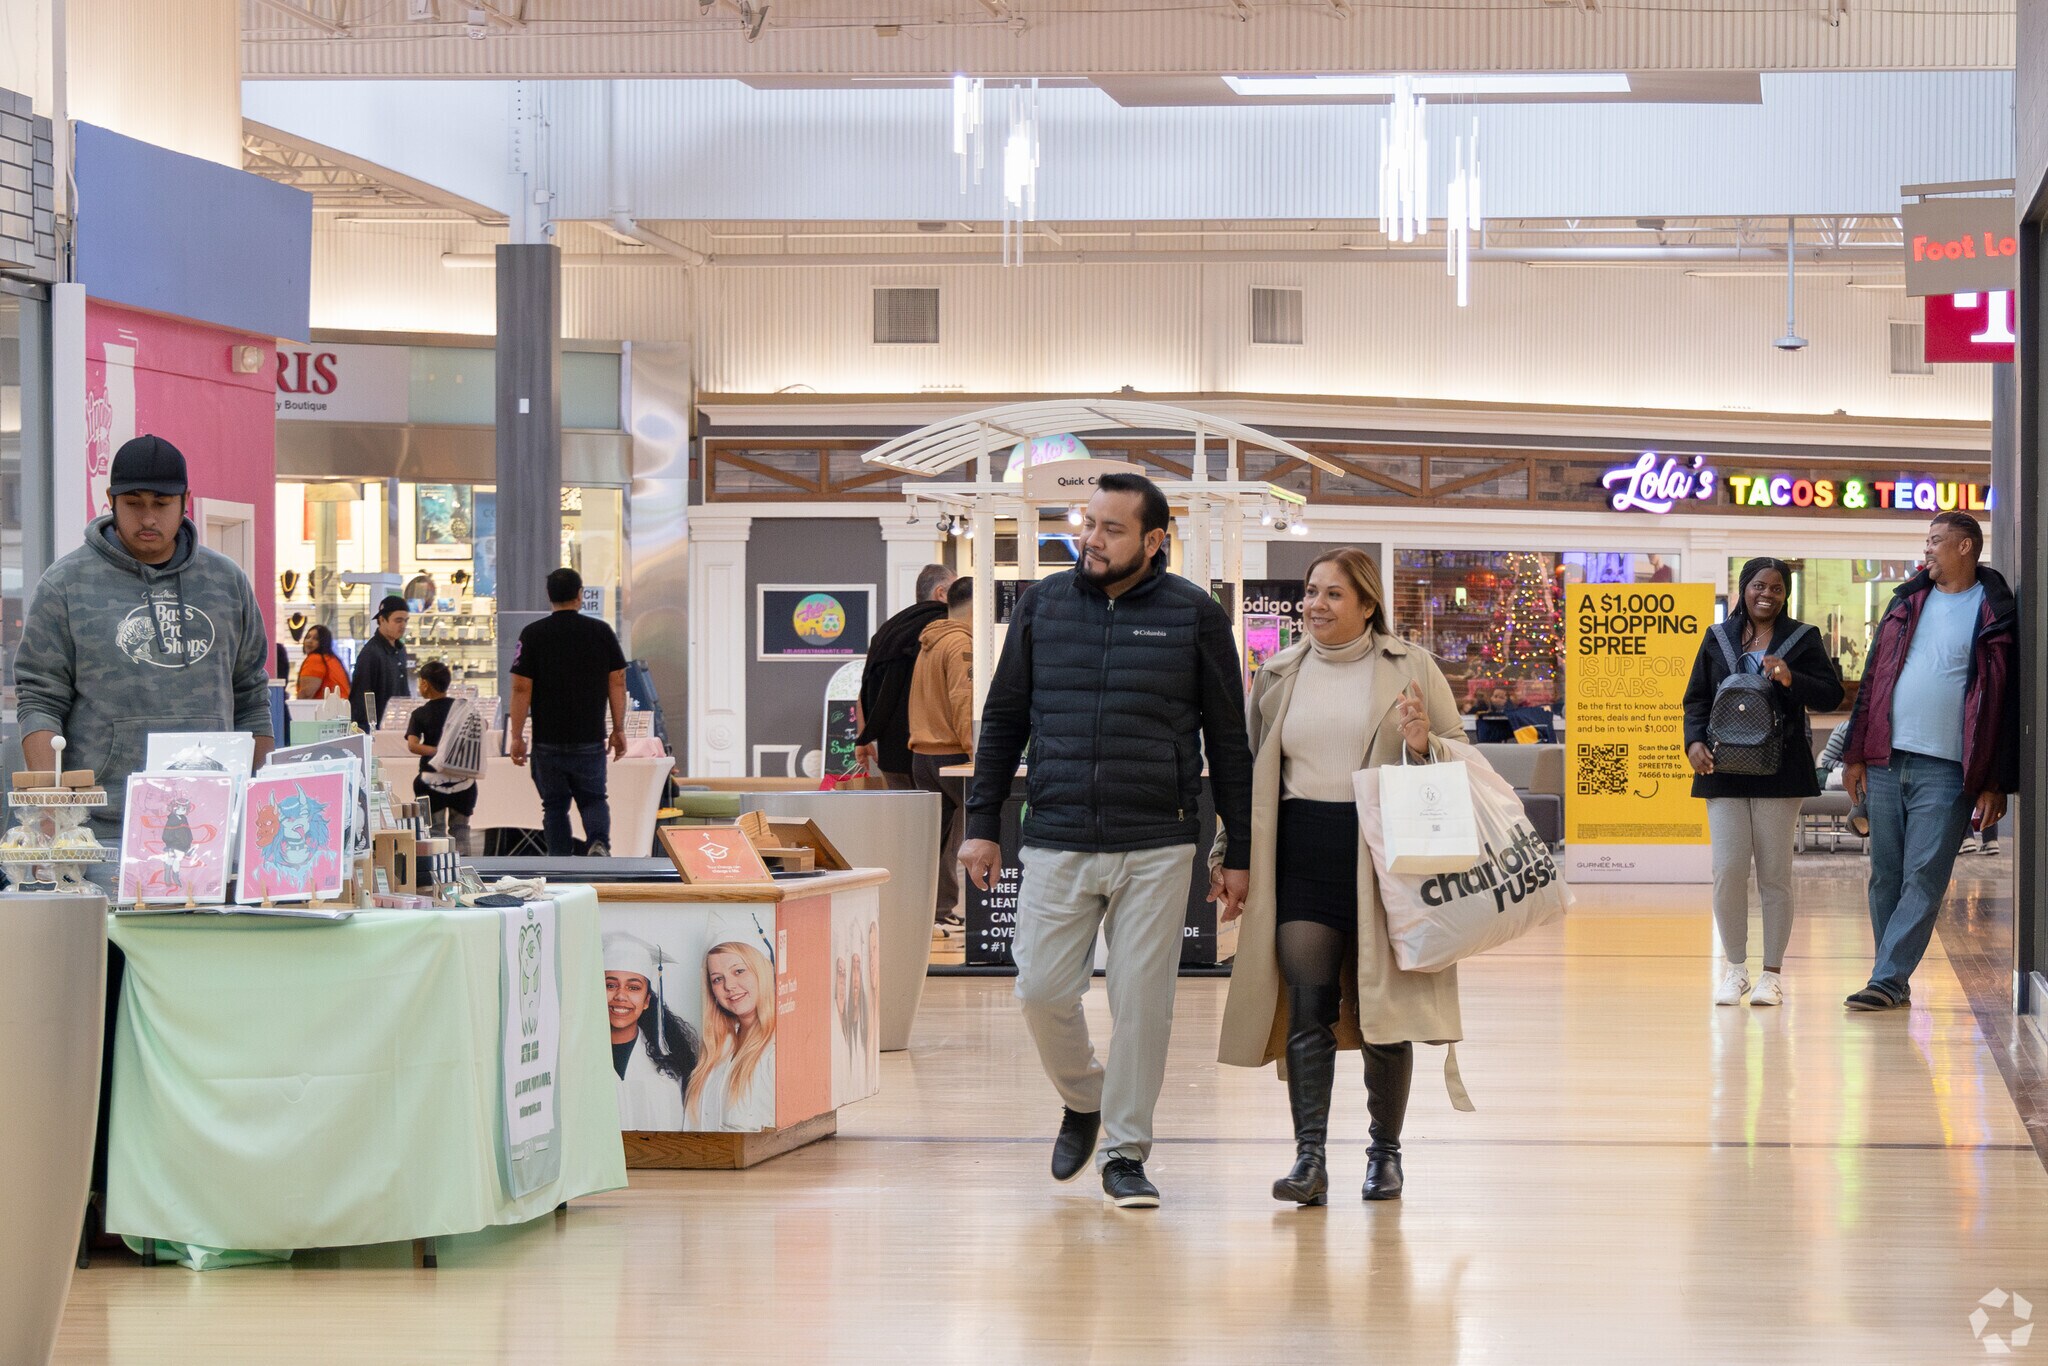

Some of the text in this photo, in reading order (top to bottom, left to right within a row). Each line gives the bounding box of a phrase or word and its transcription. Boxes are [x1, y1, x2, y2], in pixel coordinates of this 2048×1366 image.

[1913, 234, 1976, 262] Foot
[284, 400, 328, 412] Boutique
[1057, 477, 1085, 487] Quick
[1602, 451, 1714, 514] Lola's
[1729, 476, 1834, 508] TACOS
[1842, 479, 1866, 509] &
[1578, 592, 1675, 615] A $1,000
[1578, 614, 1698, 635] SHOPPING
[1578, 635, 1647, 655] SPREE
[1579, 656, 1686, 677] IS UP FOR
[1578, 676, 1664, 698] GRABS.
[1577, 702, 1588, 710] Be
[1590, 702, 1604, 710] the
[1605, 702, 1621, 710] first
[1634, 702, 1657, 710] know
[1659, 702, 1682, 710] about
[1577, 714, 1605, 722] stores,
[1606, 713, 1629, 721] deals
[1630, 713, 1646, 721] and
[1647, 713, 1662, 721] fun
[1577, 724, 1677, 733] and be in to win $1,000!
[1670, 744, 1681, 752] QR
[1671, 772, 1687, 781] sign
[1000, 868, 1019, 879] AFE
[991, 898, 1018, 908] LEAT
[991, 912, 1018, 923] CAN
[991, 941, 1007, 952] #1
